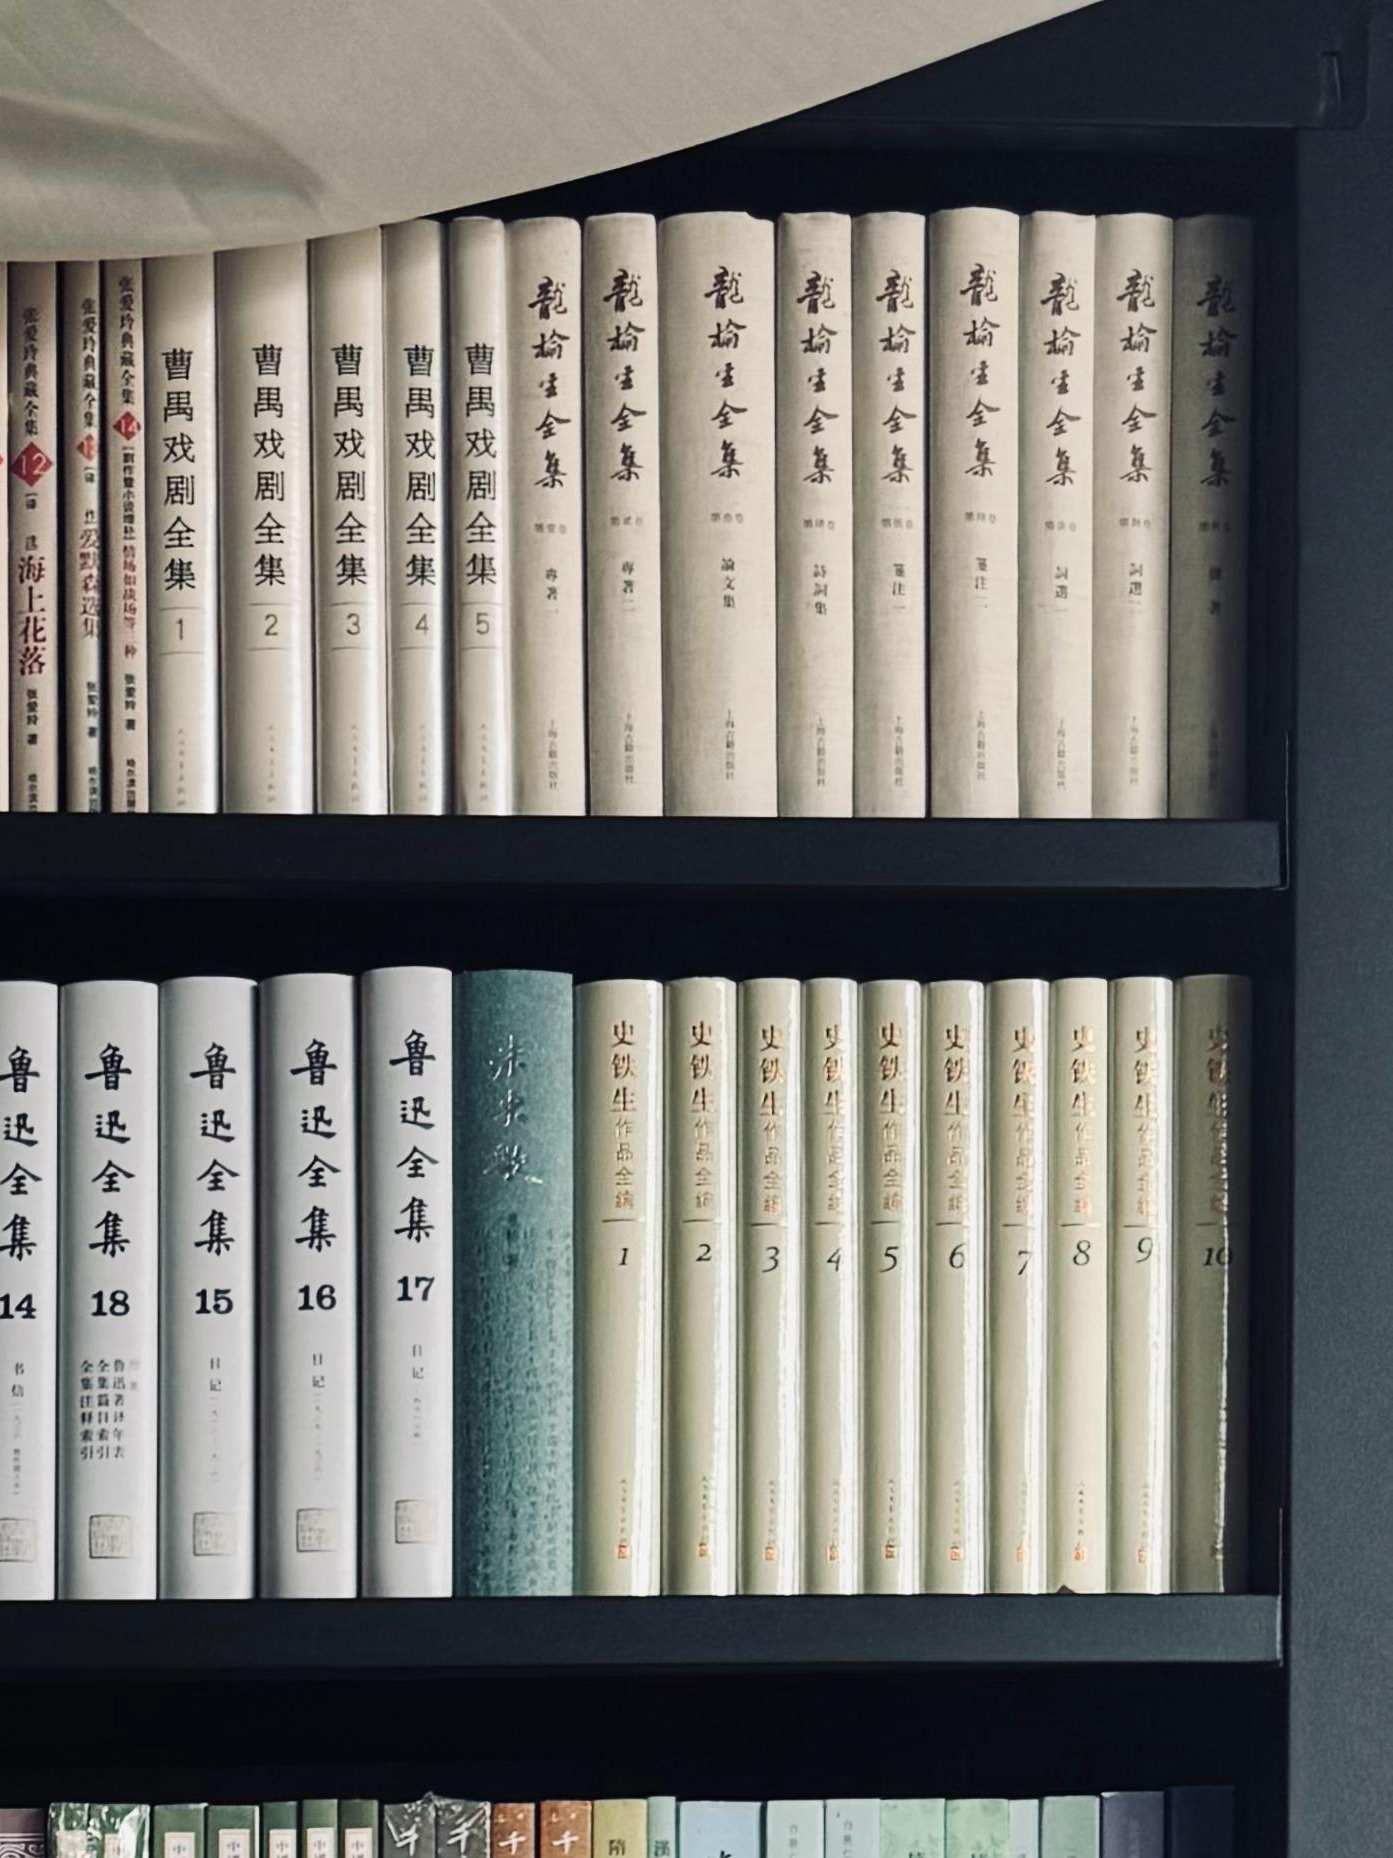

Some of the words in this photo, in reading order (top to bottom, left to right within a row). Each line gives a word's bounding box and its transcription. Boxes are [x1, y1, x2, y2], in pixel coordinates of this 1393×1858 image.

[161, 349, 196, 590] 曹禺戏剧全集
[331, 344, 367, 587] 曹禺戏剧全集
[18, 553, 47, 675] 海上花落
[264, 614, 279, 636] 2
[346, 613, 361, 635] 3
[83, 1042, 136, 1258] 鲁迅全集
[388, 1029, 438, 1244] 鲁迅全集
[695, 1242, 712, 1263] 2
[1072, 1241, 1091, 1265] 8
[395, 1275, 435, 1303] 17
[90, 1290, 130, 1317] 18
